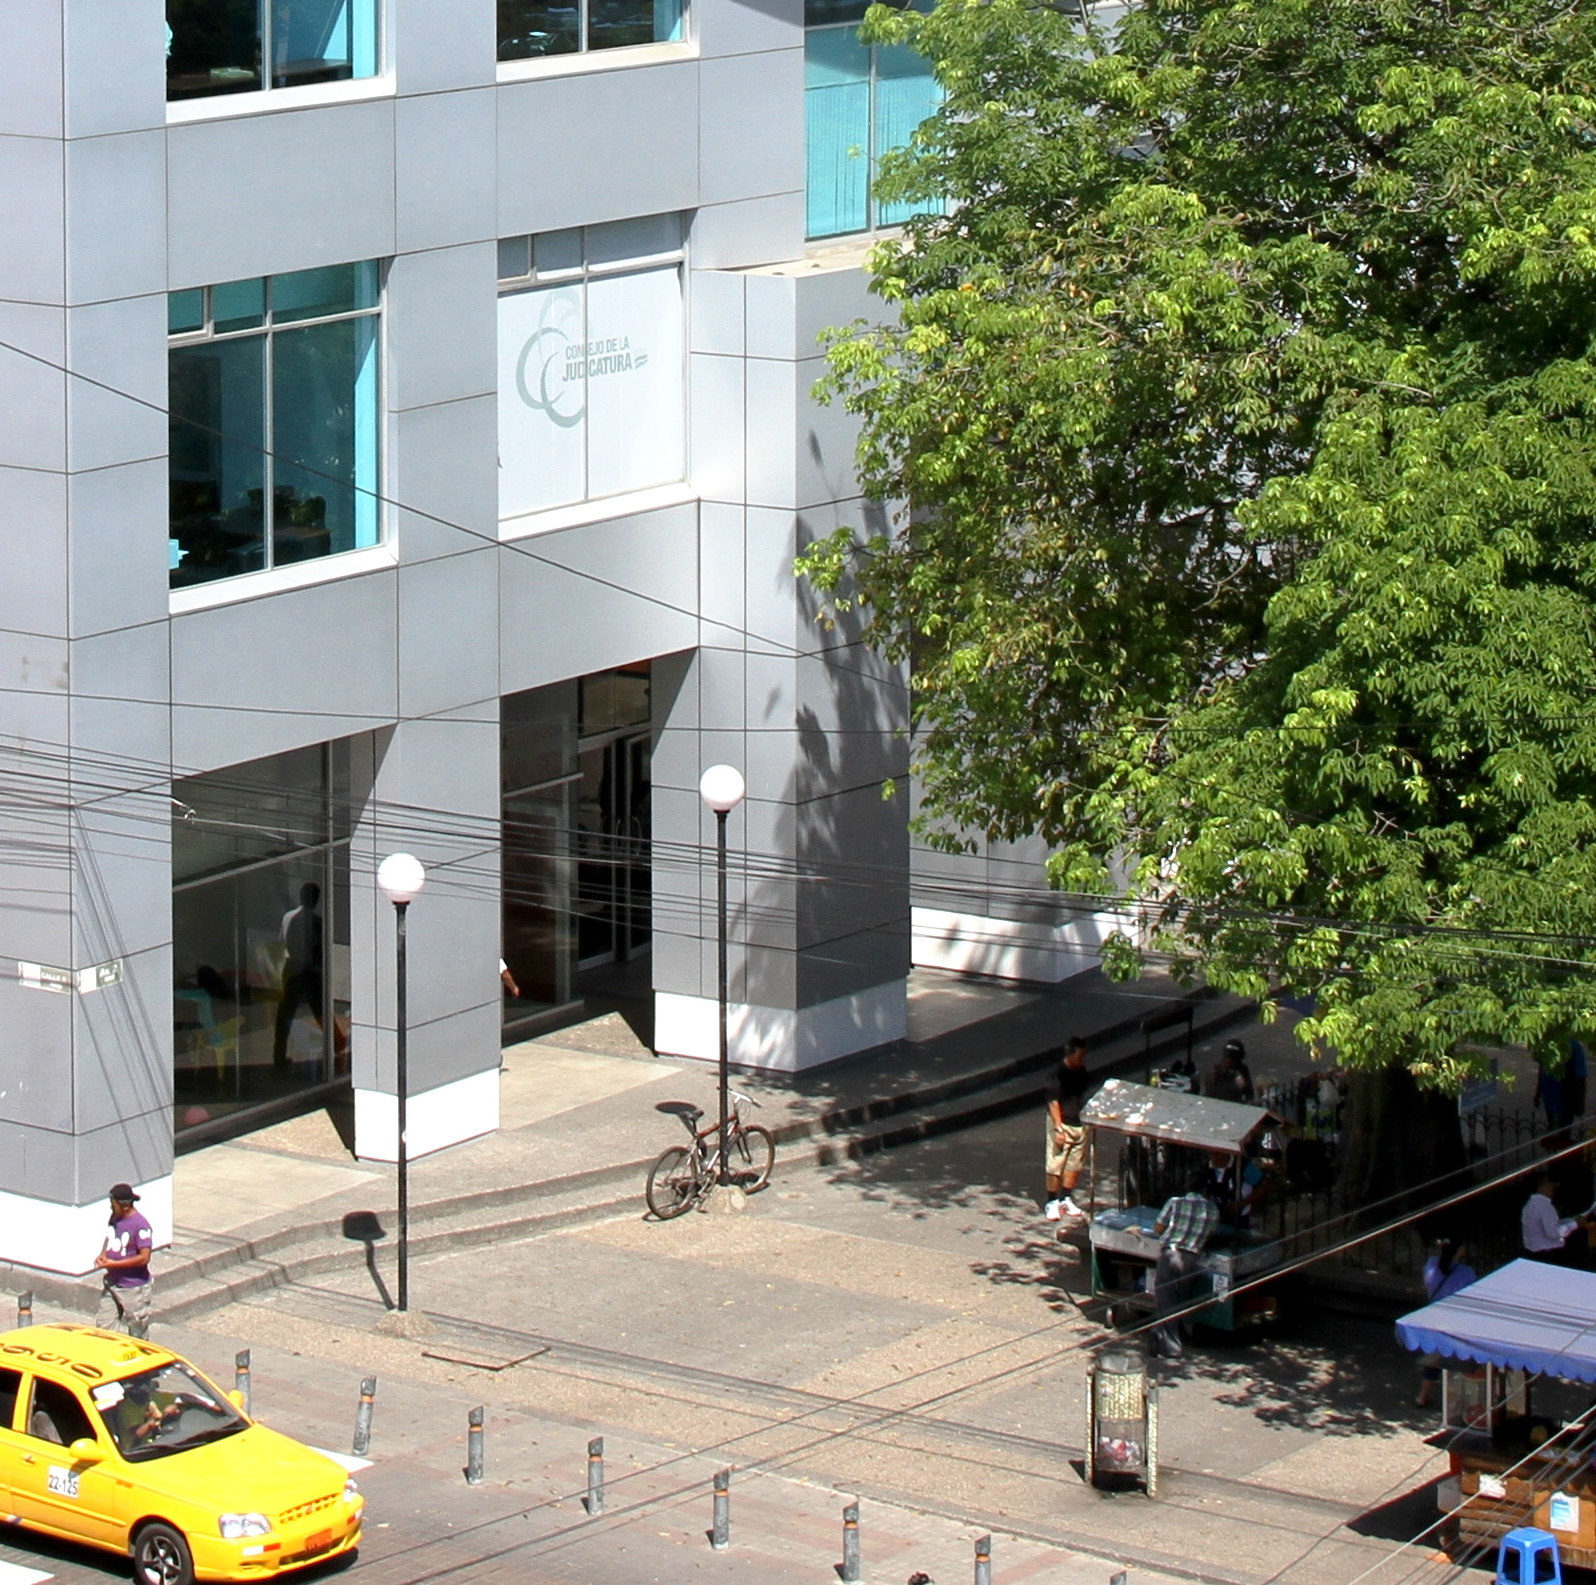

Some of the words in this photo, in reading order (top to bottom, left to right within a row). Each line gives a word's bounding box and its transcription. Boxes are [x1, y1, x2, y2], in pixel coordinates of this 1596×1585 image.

[565, 341, 605, 360] CONEJO
[606, 337, 618, 352] DE
[619, 335, 630, 351] LA
[562, 352, 633, 382] JUDCATURA
